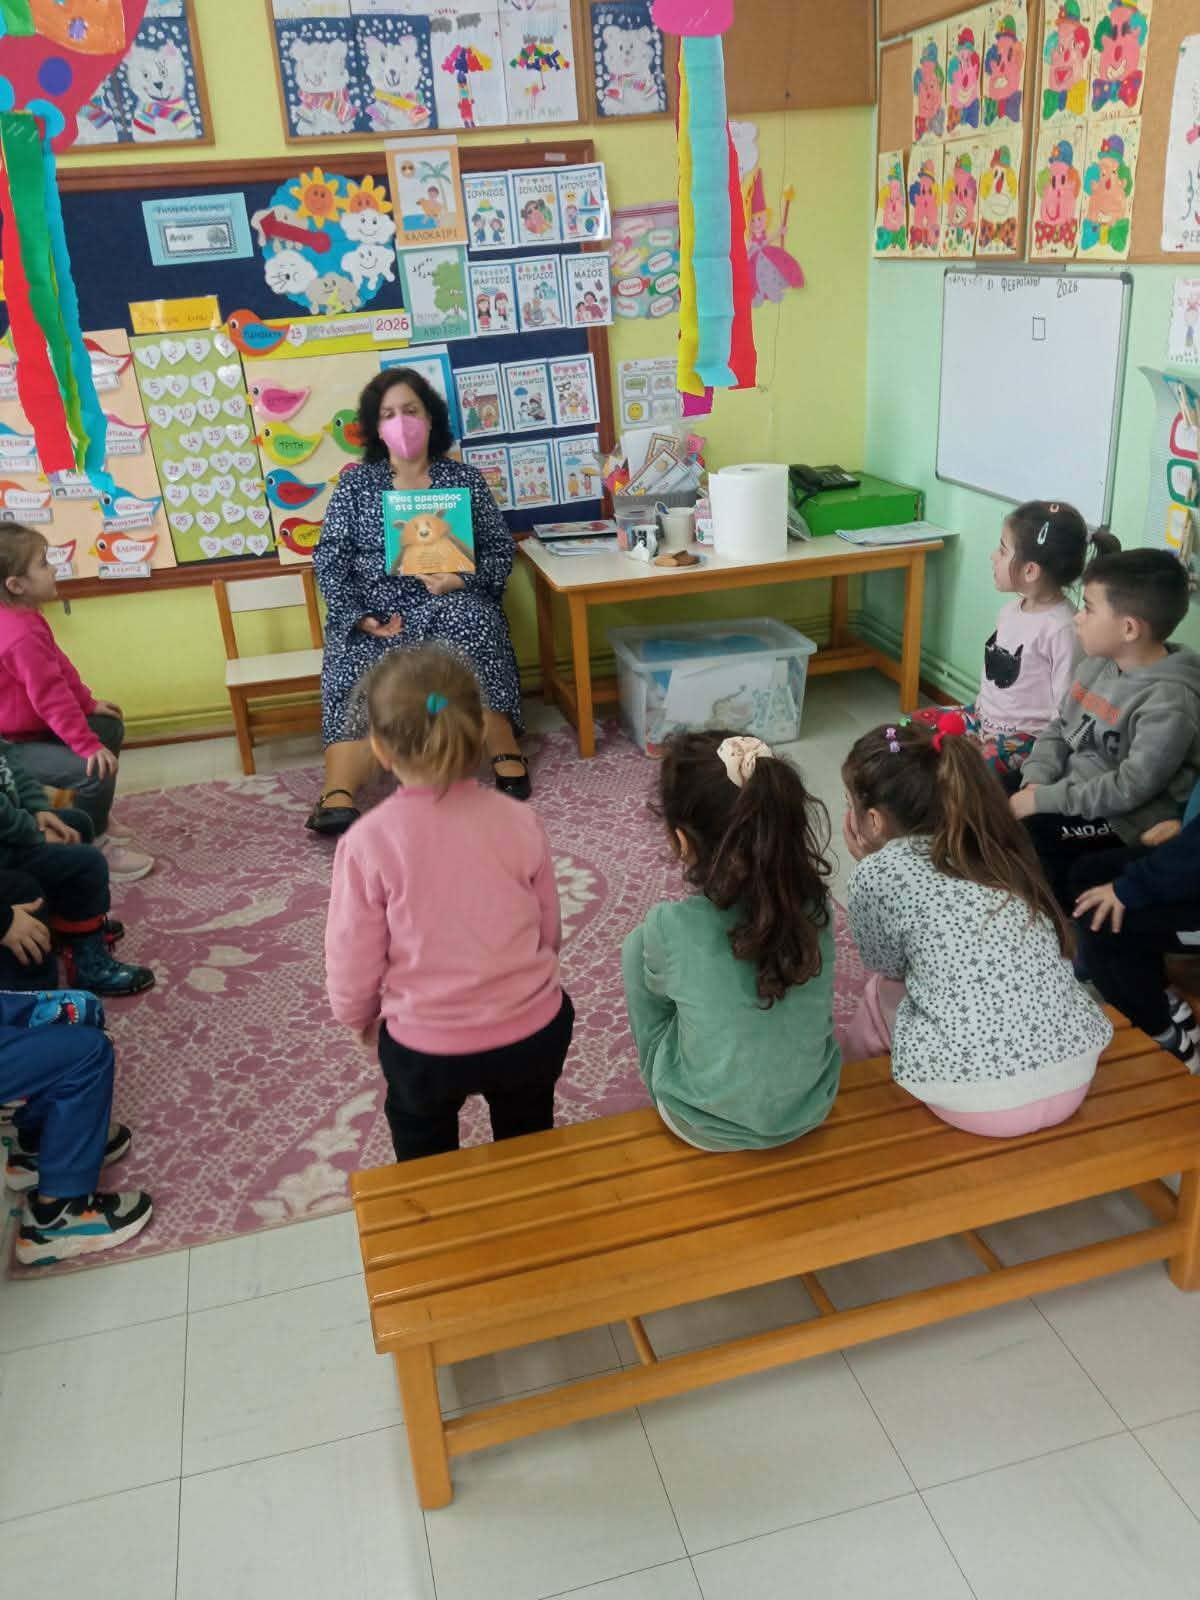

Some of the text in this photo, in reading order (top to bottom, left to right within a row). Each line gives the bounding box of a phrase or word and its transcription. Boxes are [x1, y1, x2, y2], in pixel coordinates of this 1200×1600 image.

[405, 229, 458, 241] ΚΑΛΟΚΑΙΡΙ
[574, 269, 603, 278] ΜΑΙΟΣ
[473, 277, 510, 286] ΜΑΡΤΙΟΣ
[1056, 278, 1078, 298] 2026
[375, 318, 409, 331] 2026
[145, 351, 154, 365] 1
[168, 346, 177, 359] 2
[150, 382, 160, 395] 5
[157, 408, 167, 421] 9
[179, 408, 192, 420] 10
